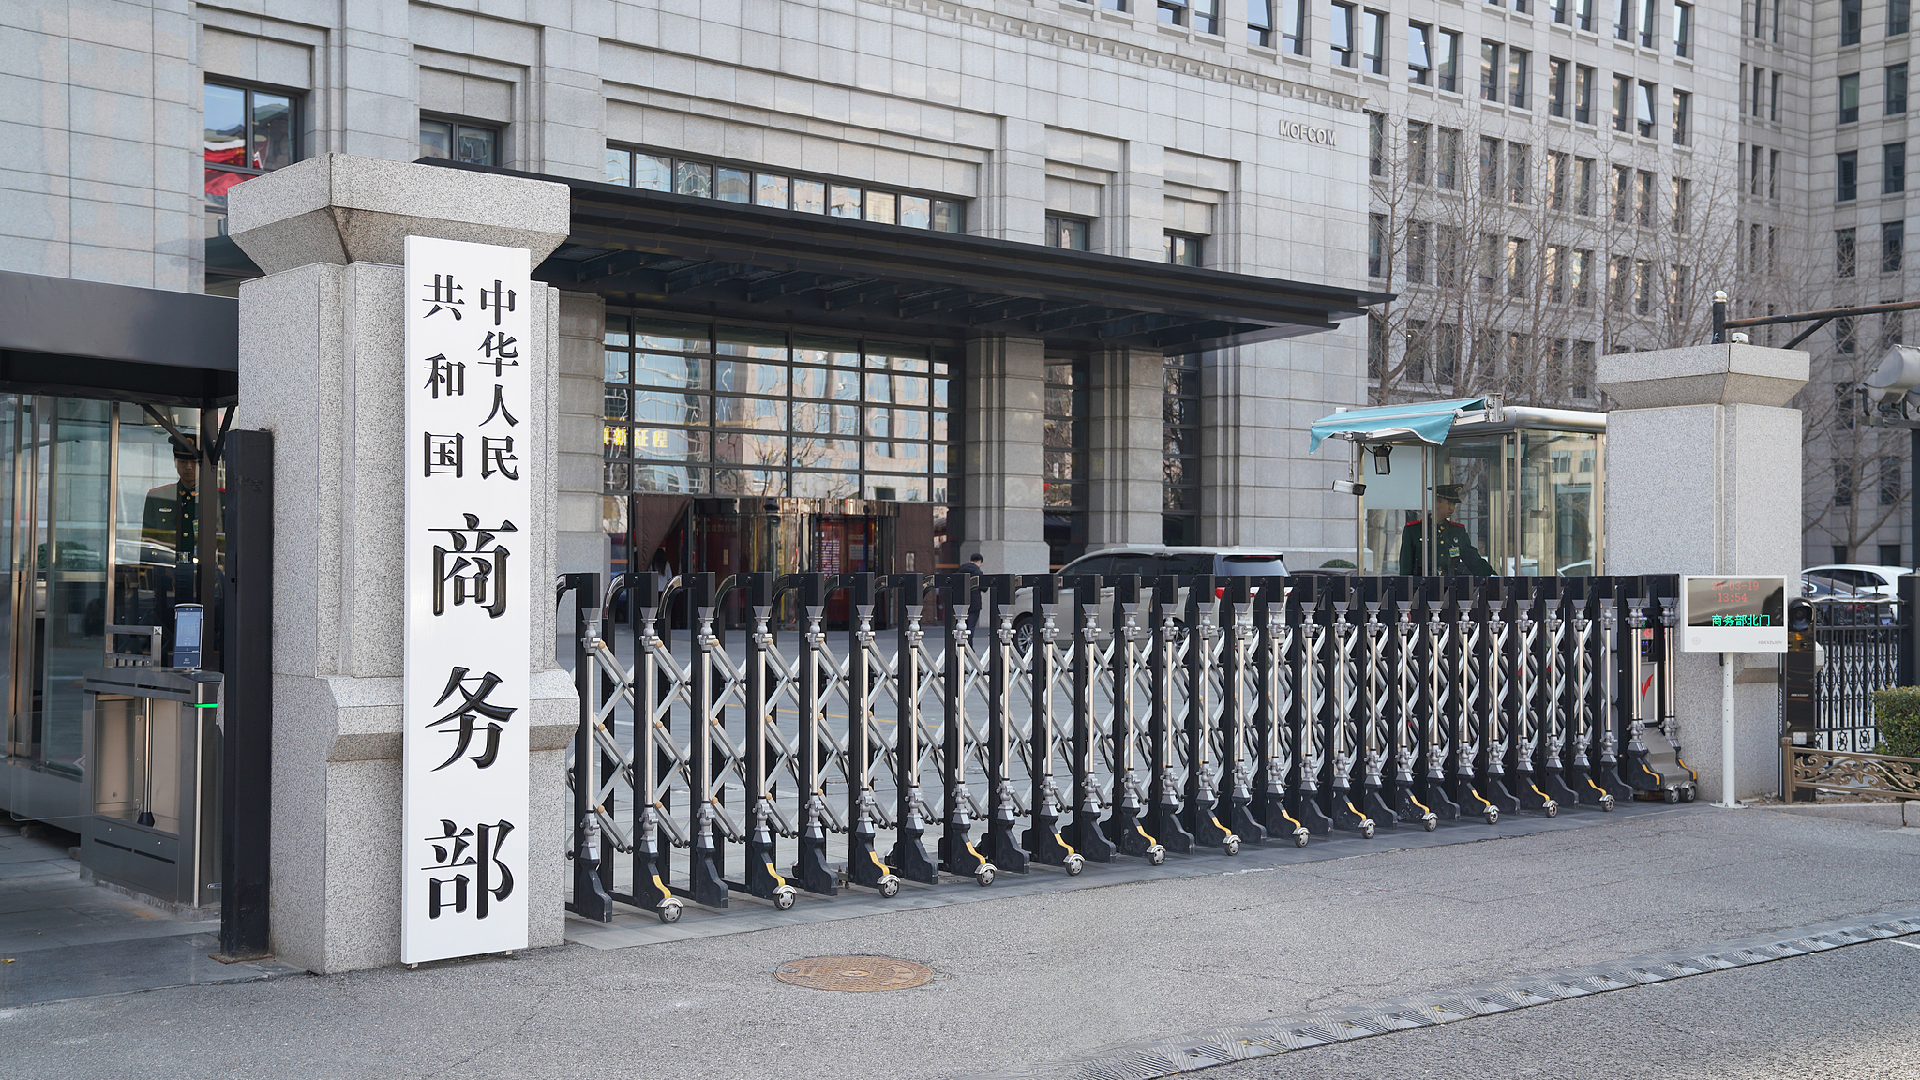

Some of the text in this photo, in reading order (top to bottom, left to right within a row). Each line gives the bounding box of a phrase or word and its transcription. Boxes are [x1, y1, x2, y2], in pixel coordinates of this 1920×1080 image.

[1279, 120, 1337, 146] MOFCOM
[422, 274, 465, 479] 共和国
[478, 280, 519, 481] 中华人民
[1711, 581, 1759, 591] 26-03-19
[1717, 593, 1748, 603] 13:54
[1711, 614, 1771, 627] 商务部北门
[421, 513, 518, 920] 商务部
